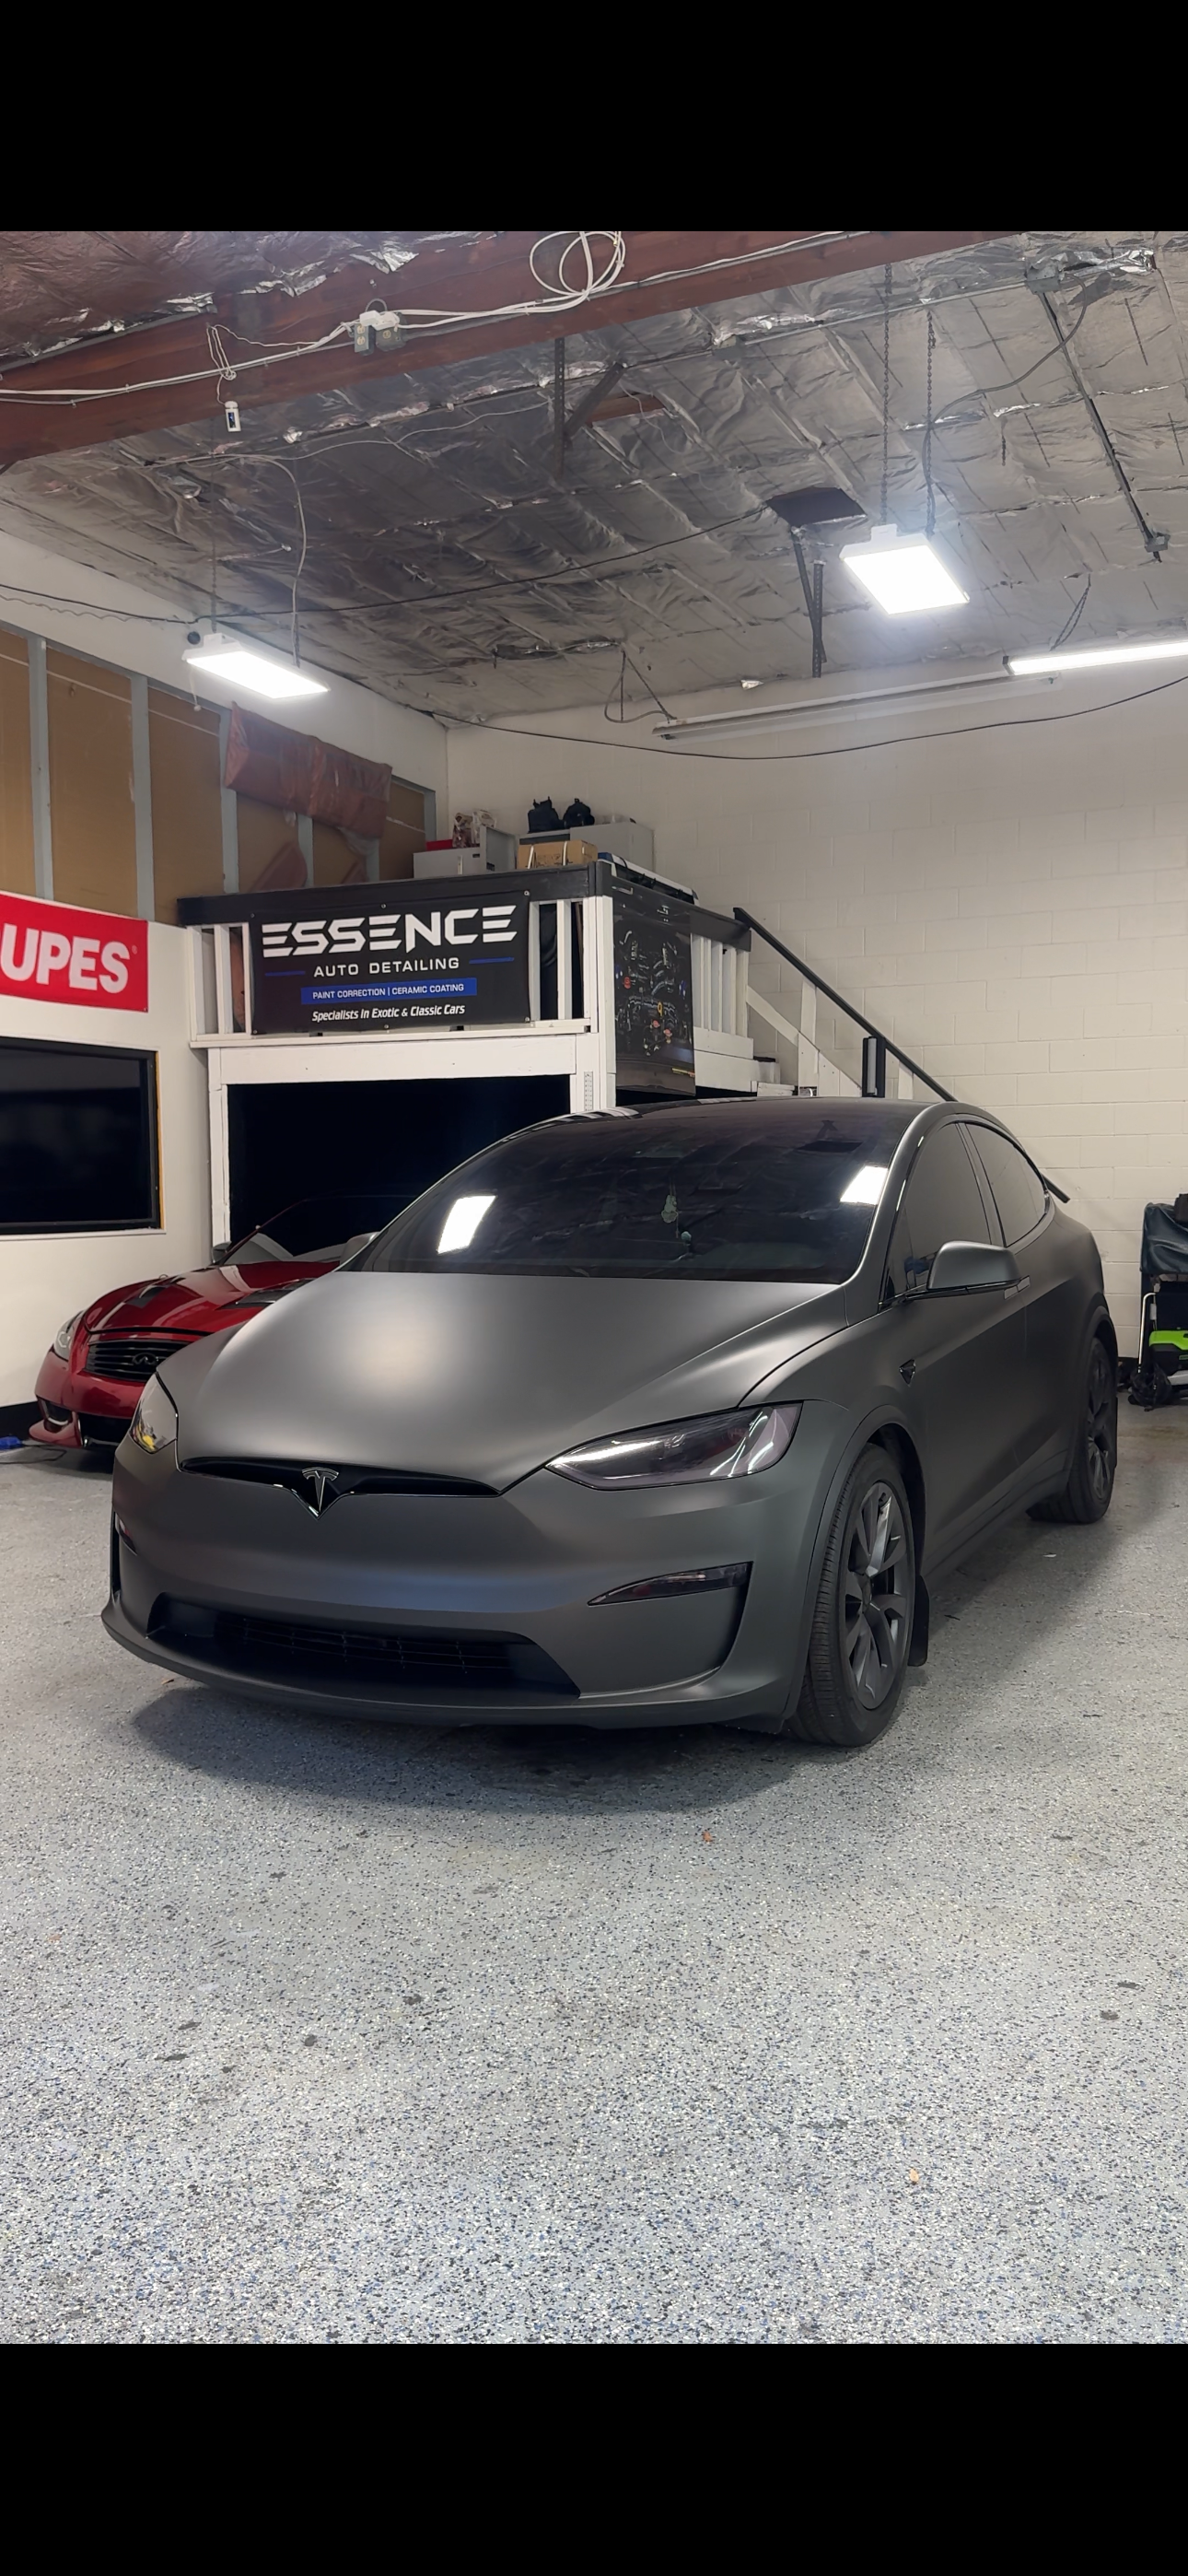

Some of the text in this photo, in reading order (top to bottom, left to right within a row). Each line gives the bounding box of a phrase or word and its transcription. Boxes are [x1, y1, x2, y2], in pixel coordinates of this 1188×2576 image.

[262, 905, 518, 958] ESSENCE
[0, 923, 130, 994] UPES
[313, 957, 460, 978] AUTO DETAILING
[312, 990, 335, 1000] PAINT
[337, 988, 386, 998] CORRECTION
[391, 985, 428, 995] CERAMIC
[429, 983, 464, 993] COATING
[311, 1010, 359, 1023] Specialists
[371, 1007, 400, 1019] Exotic
[401, 1007, 408, 1017] &
[410, 1004, 442, 1017] Classic
[443, 1003, 466, 1015] Cars
